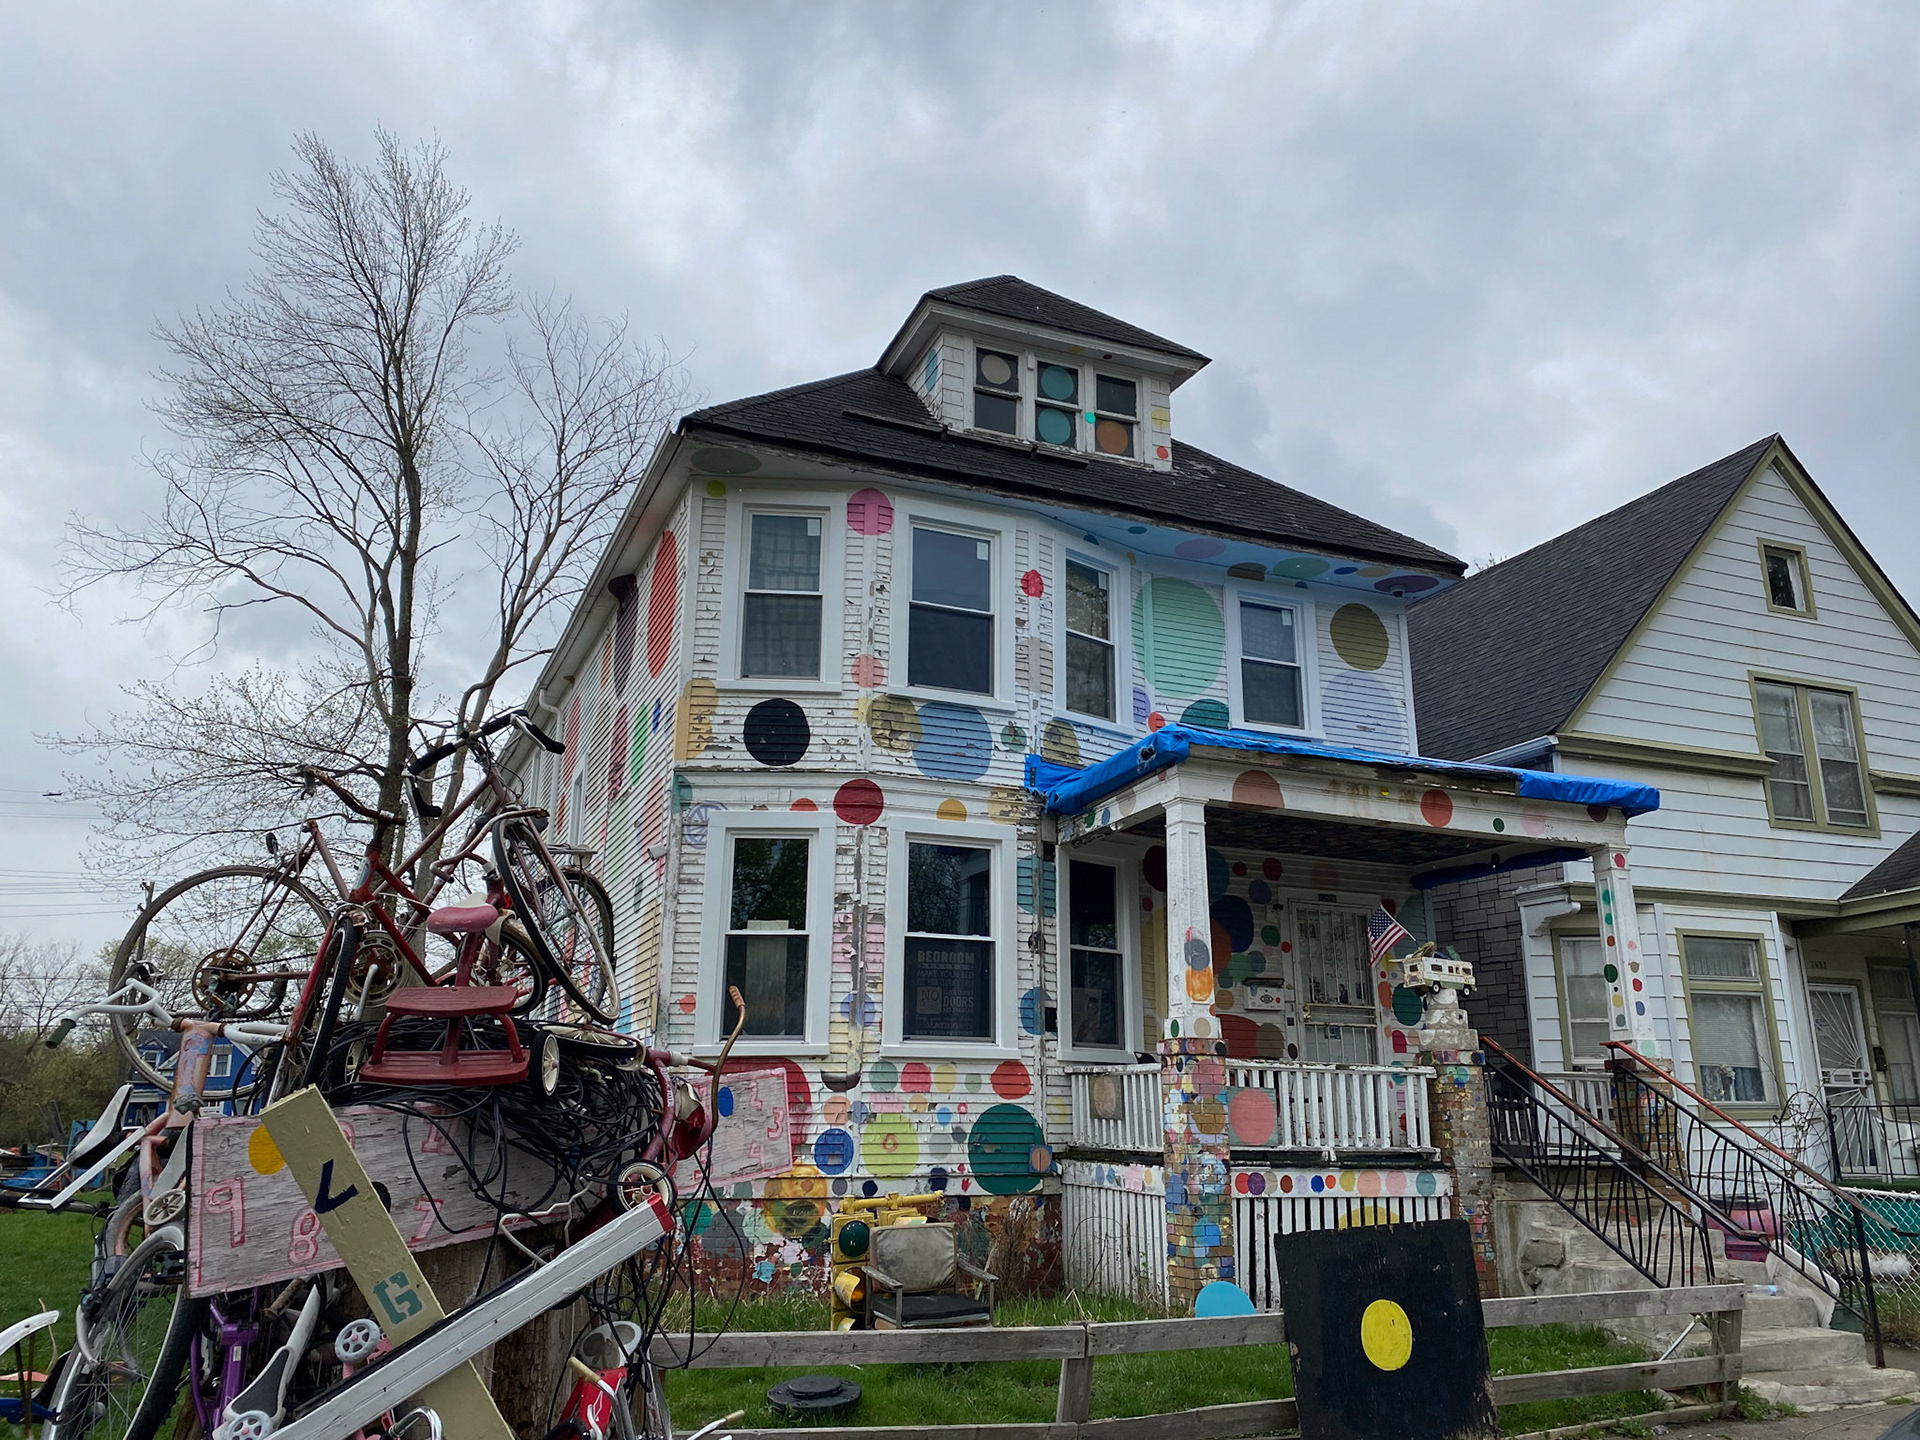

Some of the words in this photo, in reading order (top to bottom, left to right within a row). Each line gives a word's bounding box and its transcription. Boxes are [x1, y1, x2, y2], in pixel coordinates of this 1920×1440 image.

[917, 951, 975, 964] BEDROOM
[921, 990, 940, 1001] NO
[943, 996, 975, 1008] DOORS
[766, 1107, 784, 1140] 3
[748, 1140, 766, 1169] 4
[205, 1176, 245, 1248] 9
[407, 1196, 444, 1248] 7
[287, 1206, 322, 1267] 8
